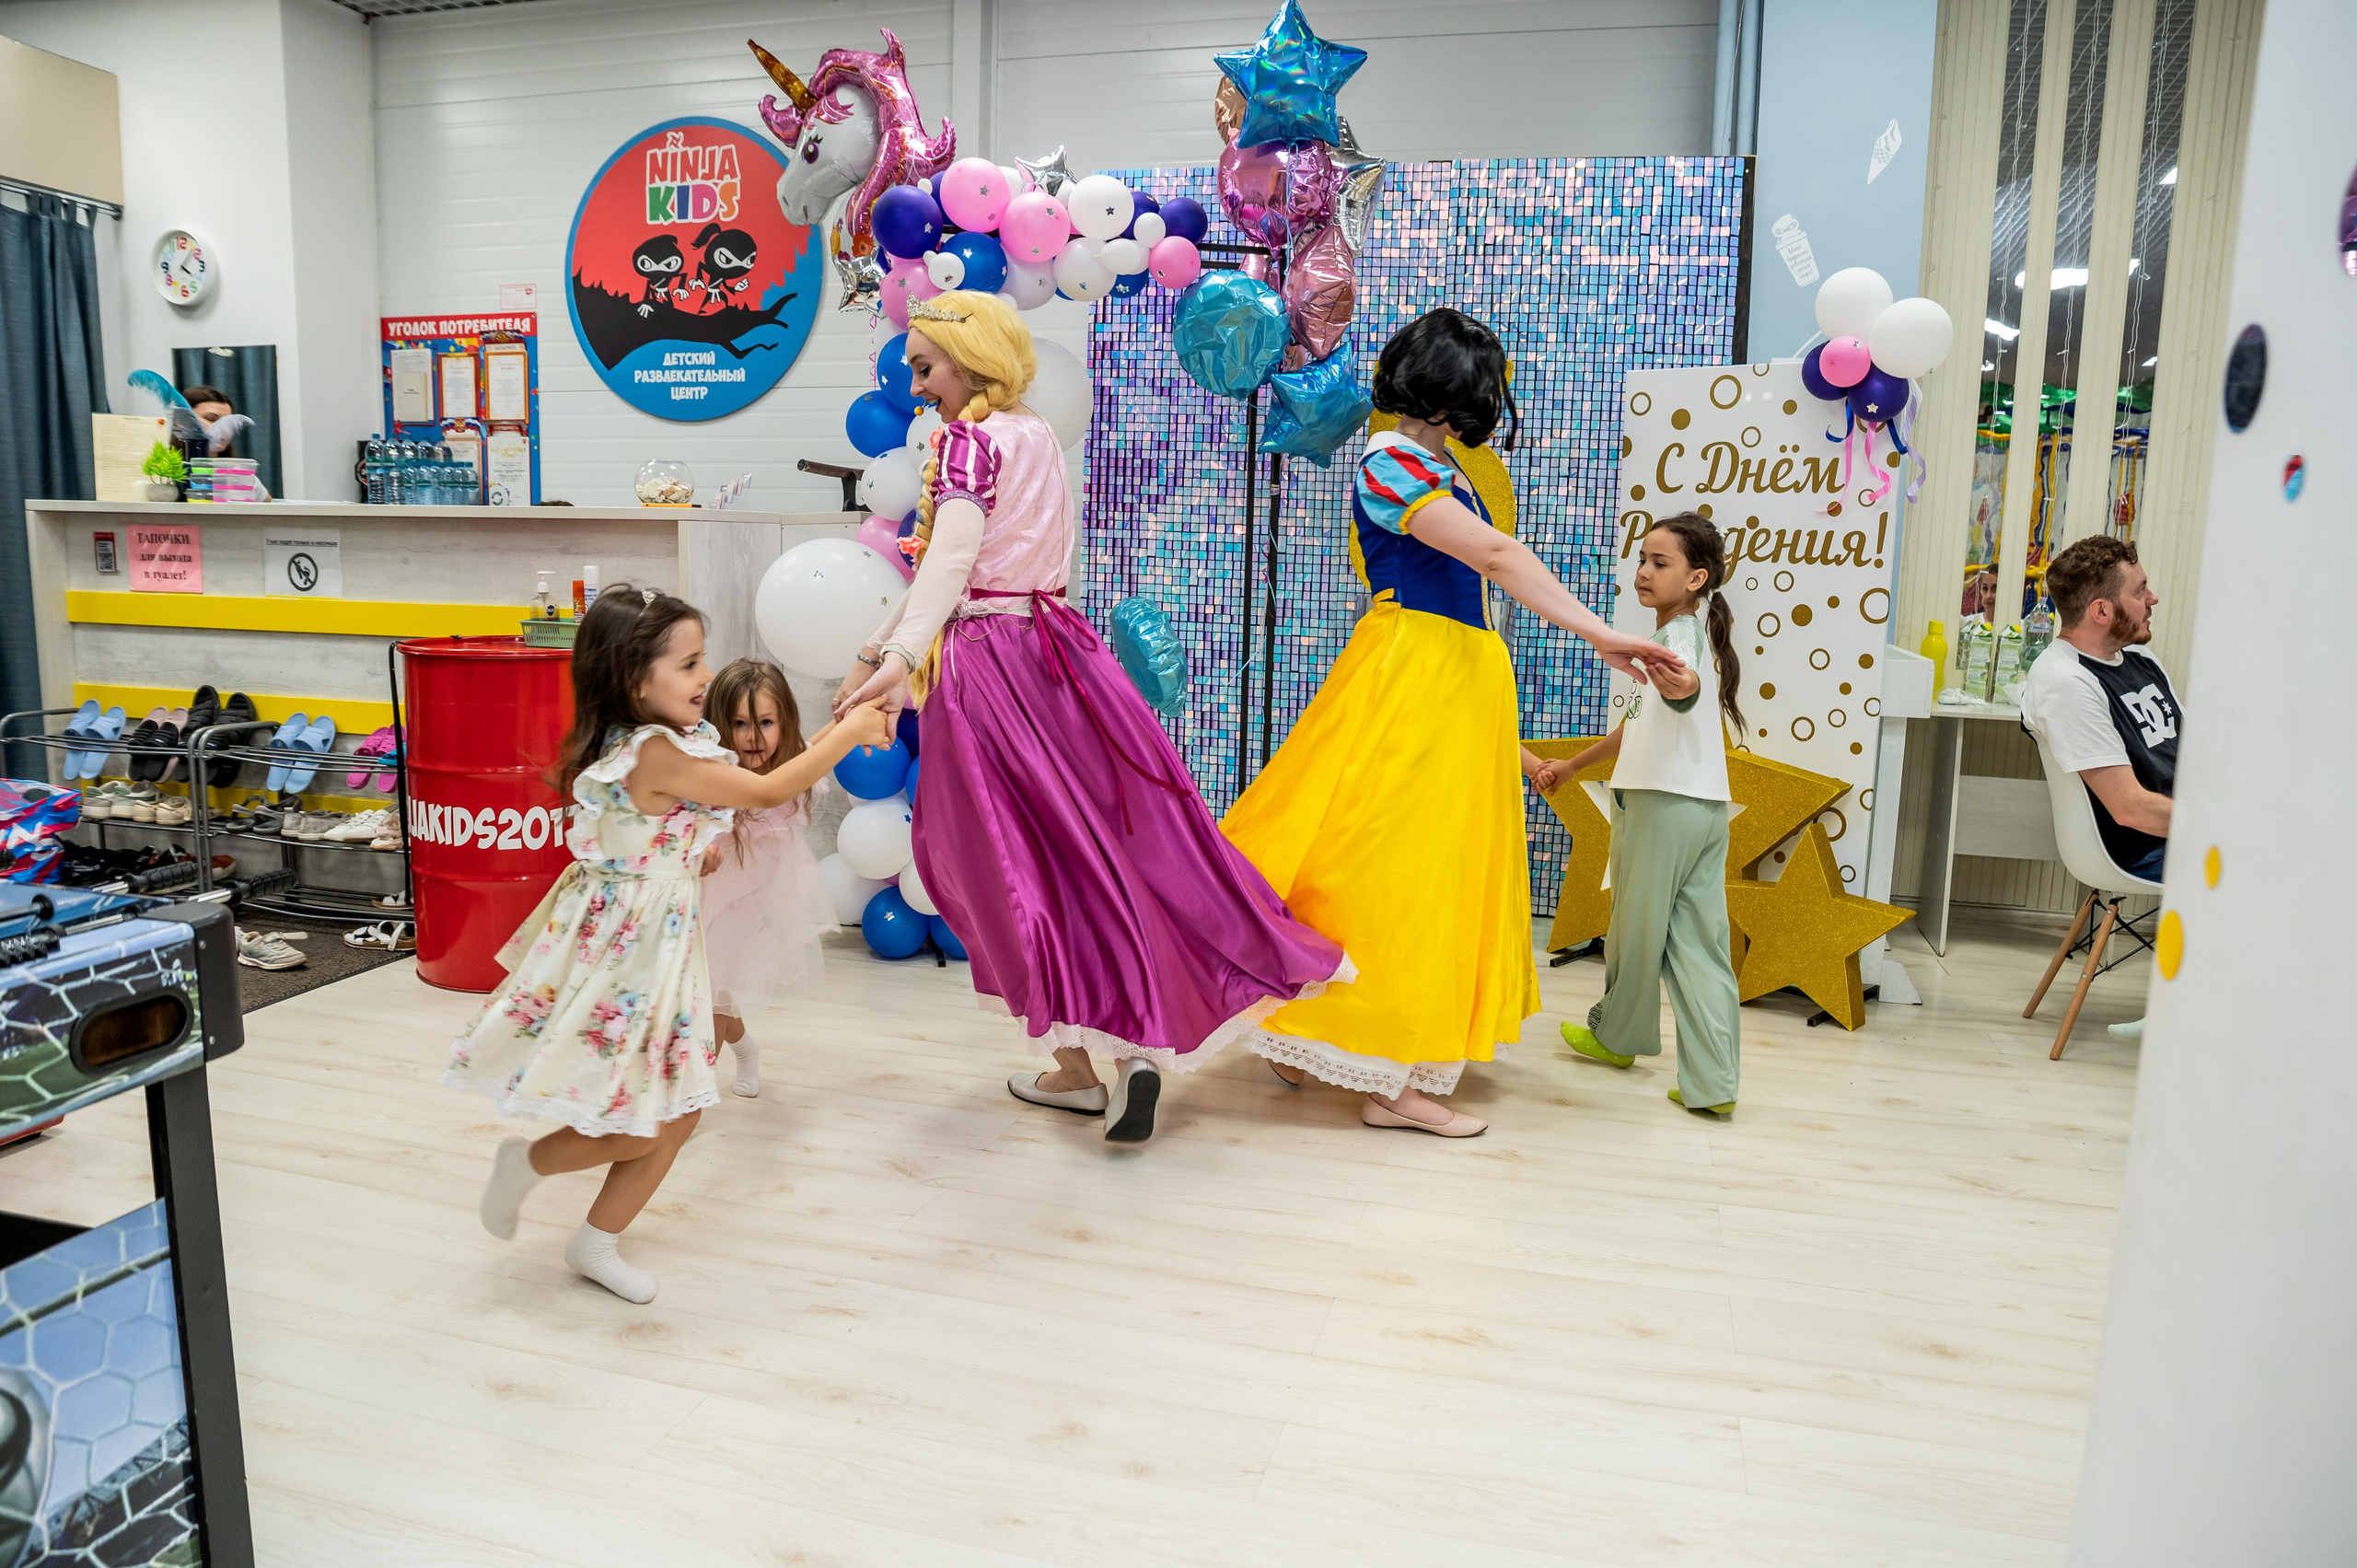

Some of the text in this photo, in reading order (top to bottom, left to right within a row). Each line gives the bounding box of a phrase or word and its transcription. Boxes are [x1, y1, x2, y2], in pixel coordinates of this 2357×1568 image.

[646, 132, 740, 183] NINJA
[646, 181, 740, 225] KIDS
[176, 237, 188, 250] 12
[193, 248, 201, 261] 2
[160, 261, 169, 273] 9
[198, 260, 205, 273] 3
[165, 273, 173, 286] 8
[172, 281, 179, 294] 7
[180, 285, 189, 297] 6
[190, 281, 198, 293] 5
[388, 317, 531, 337] УГОЛОК ПОТРЕБИТЕЛЯ
[662, 350, 716, 366] ДЕТСКИЙ
[633, 366, 746, 383] РАЗВЛЕКАТЕЛЬНЫЙ
[670, 386, 709, 401] ЦЕНТР
[1655, 439, 1846, 495] С Днём
[136, 532, 191, 545] ТАПОЧКИ
[1620, 509, 1889, 587] Рдения!
[139, 553, 192, 563] для выхода
[145, 570, 187, 582] в туалет!
[408, 796, 584, 851] JAKIDS201
